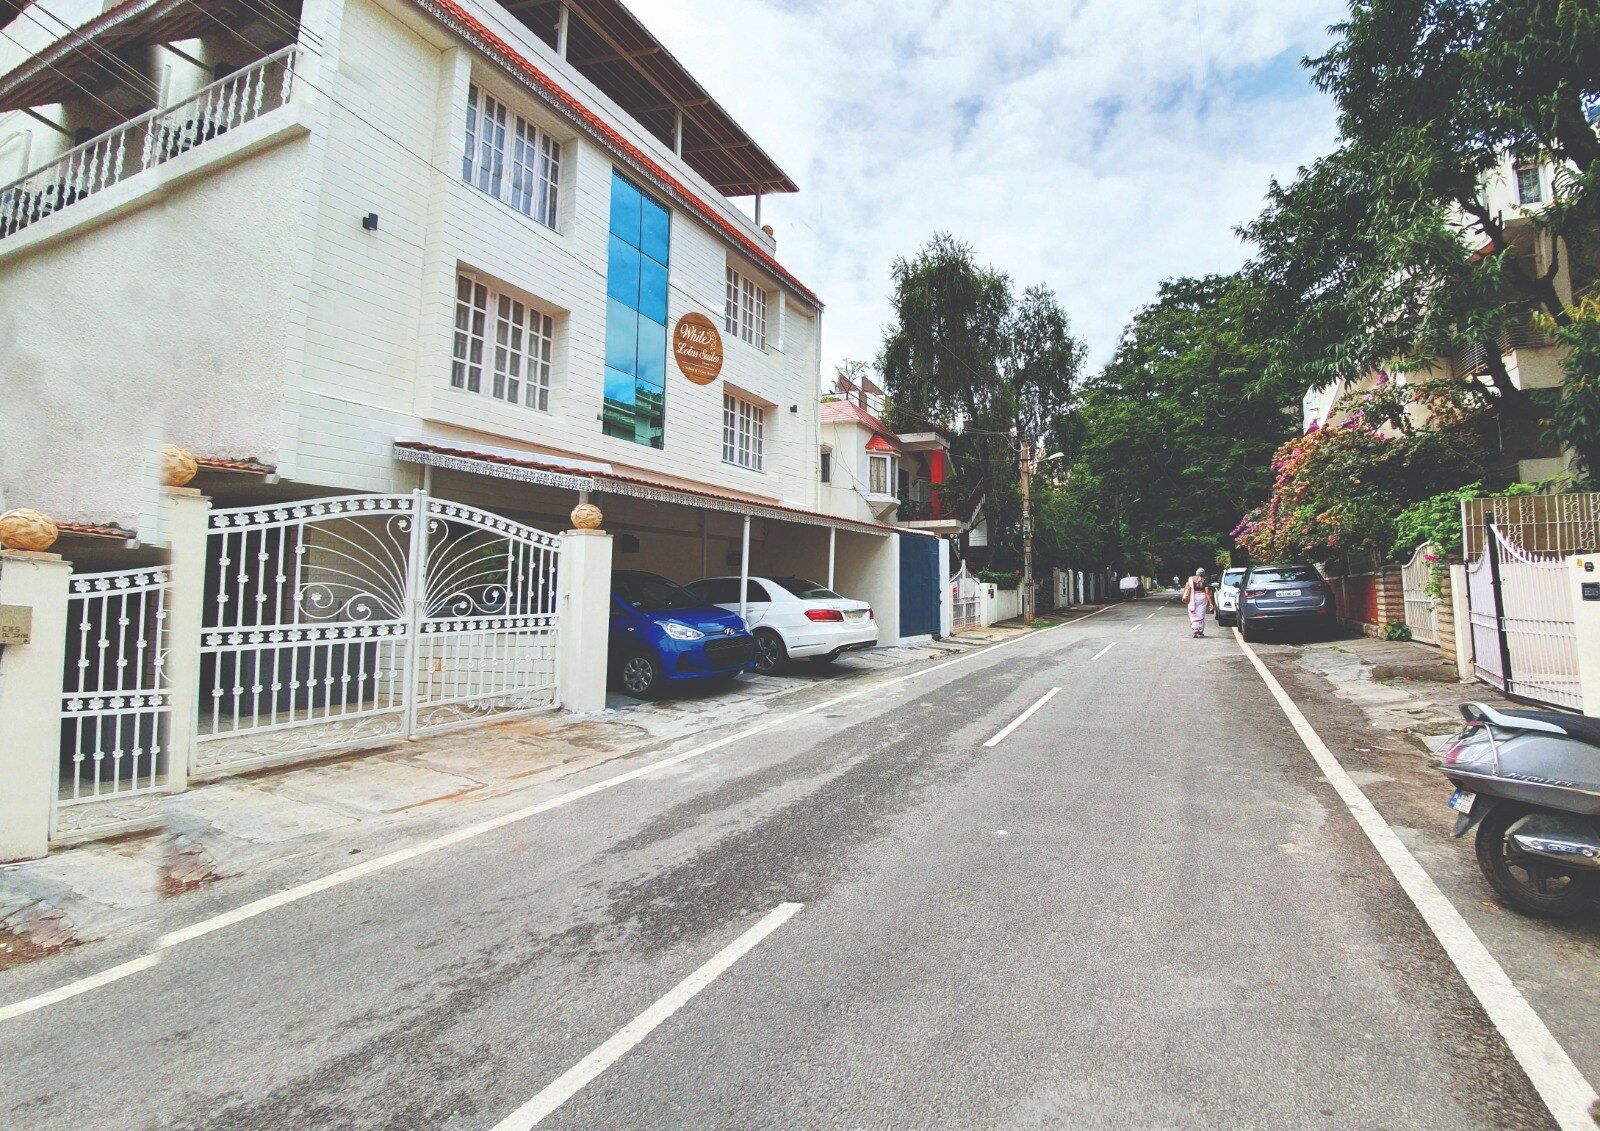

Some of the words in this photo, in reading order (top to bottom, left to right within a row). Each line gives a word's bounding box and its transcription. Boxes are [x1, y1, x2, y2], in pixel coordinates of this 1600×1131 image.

[681, 324, 710, 345] White
[676, 342, 699, 358] Lotus
[699, 349, 720, 363] Suites
